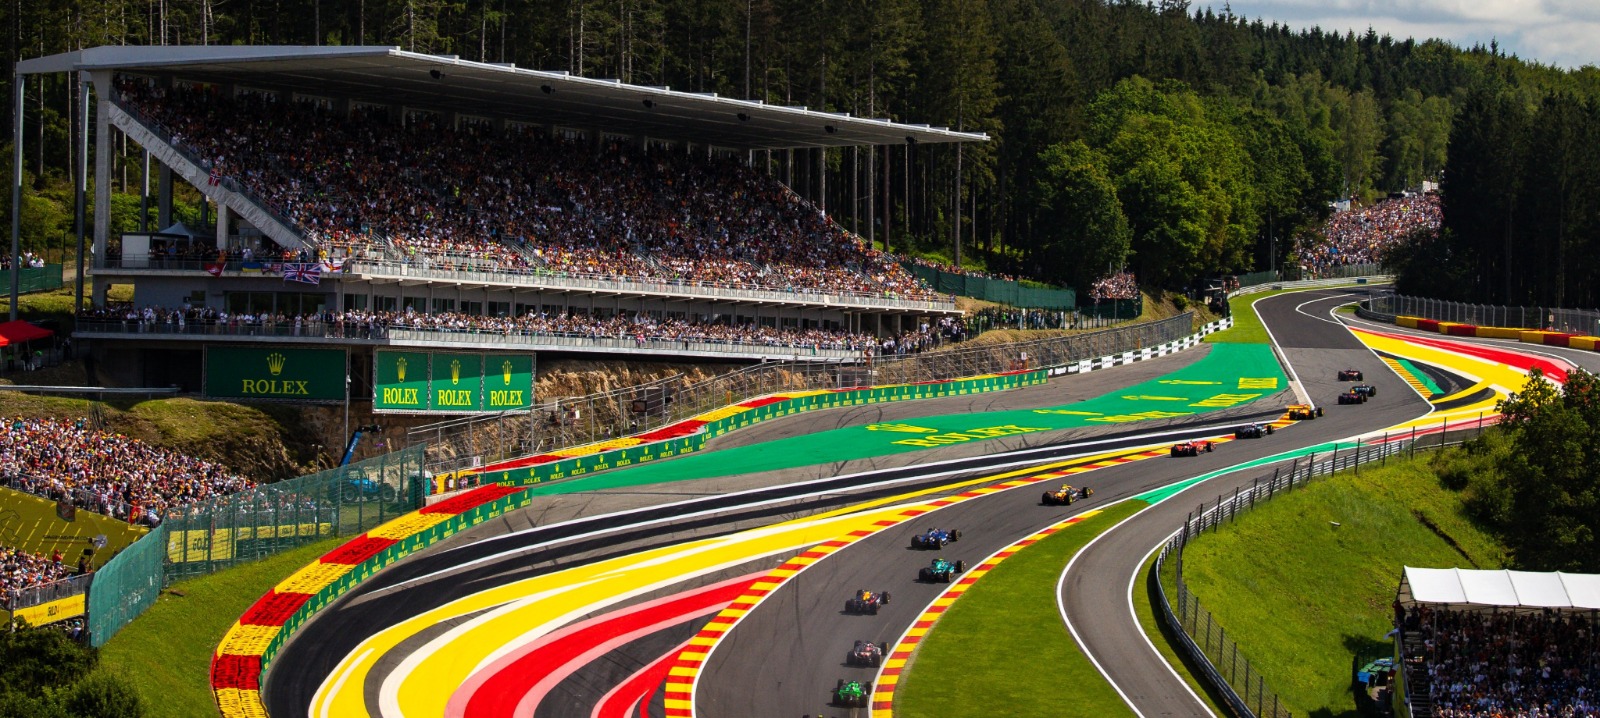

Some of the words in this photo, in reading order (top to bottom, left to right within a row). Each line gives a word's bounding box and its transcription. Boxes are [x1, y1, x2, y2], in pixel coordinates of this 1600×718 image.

[242, 379, 309, 395] ROLEX
[383, 387, 419, 405] ROLEX
[437, 389, 472, 406] ROLEX
[490, 390, 523, 406] ROLEX
[523, 476, 541, 484] ROLEX
